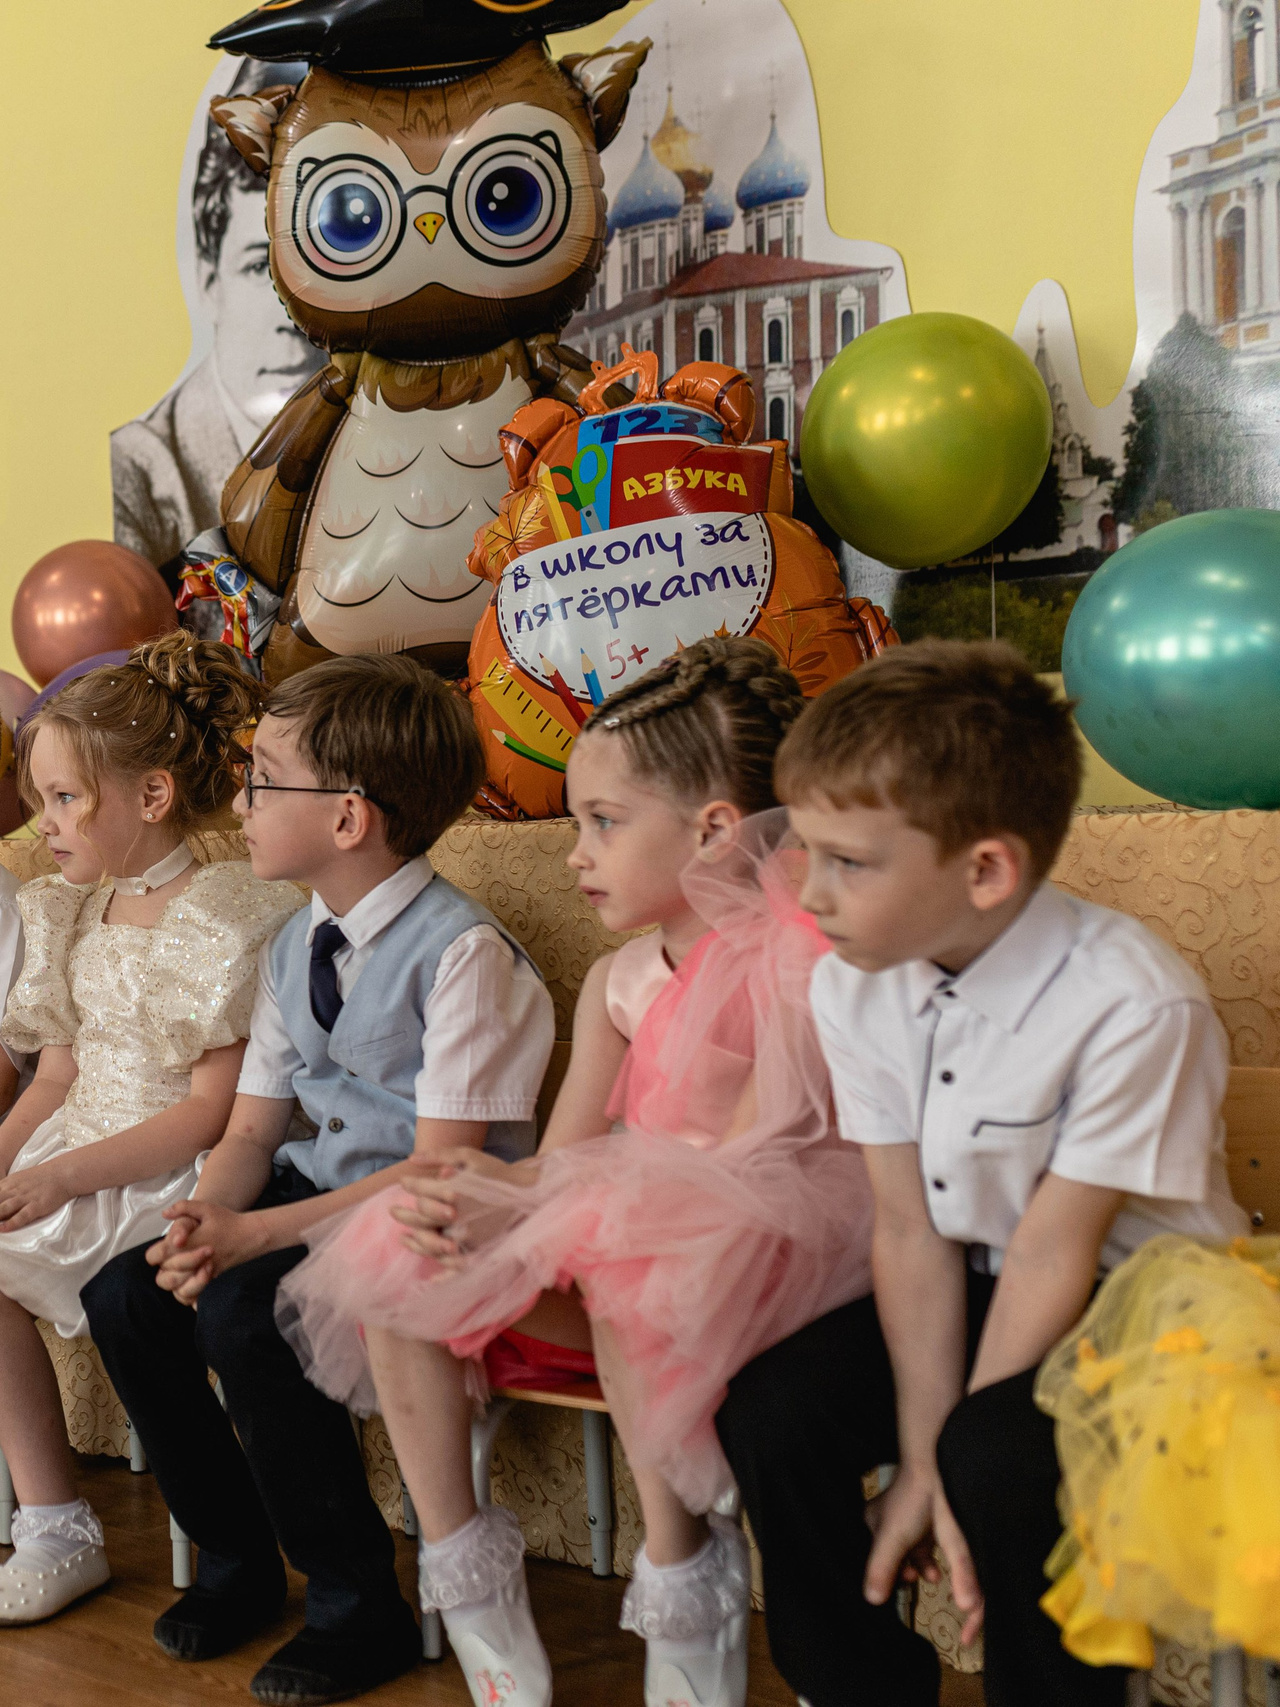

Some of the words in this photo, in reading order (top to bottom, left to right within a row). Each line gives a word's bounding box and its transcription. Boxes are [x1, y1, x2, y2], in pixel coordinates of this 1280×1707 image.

[592, 408, 702, 444] 123
[622, 467, 748, 501] АЗБУКА
[540, 532, 685, 580] школу
[695, 520, 750, 546] за
[514, 564, 758, 634] пятёрками
[606, 638, 649, 680] 5+
